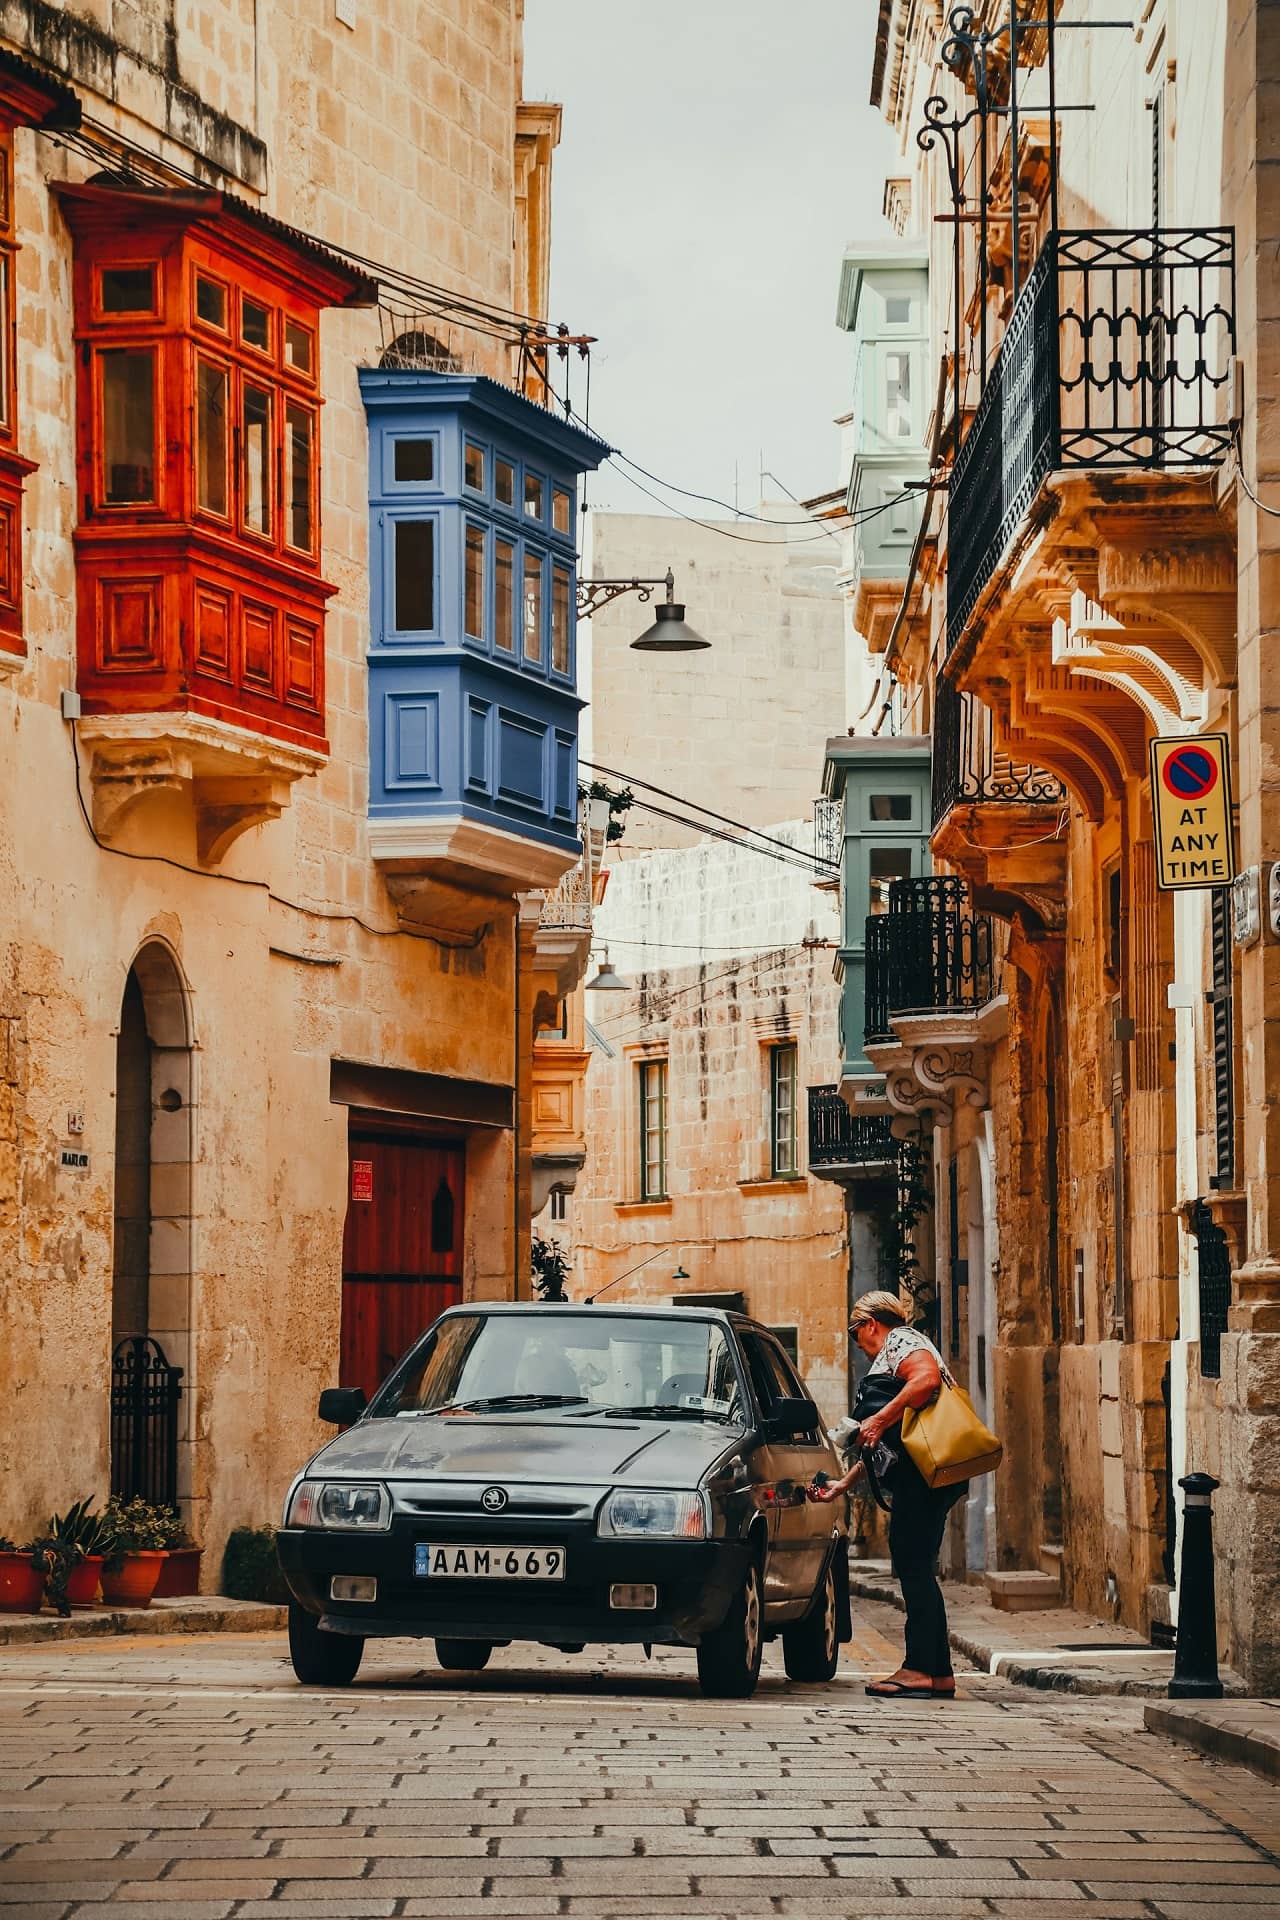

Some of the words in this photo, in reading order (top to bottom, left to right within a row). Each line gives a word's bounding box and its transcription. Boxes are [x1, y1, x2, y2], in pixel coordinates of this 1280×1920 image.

[1180, 807, 1207, 825] AT
[1171, 833, 1219, 852] ANY
[1167, 859, 1225, 879] TIME
